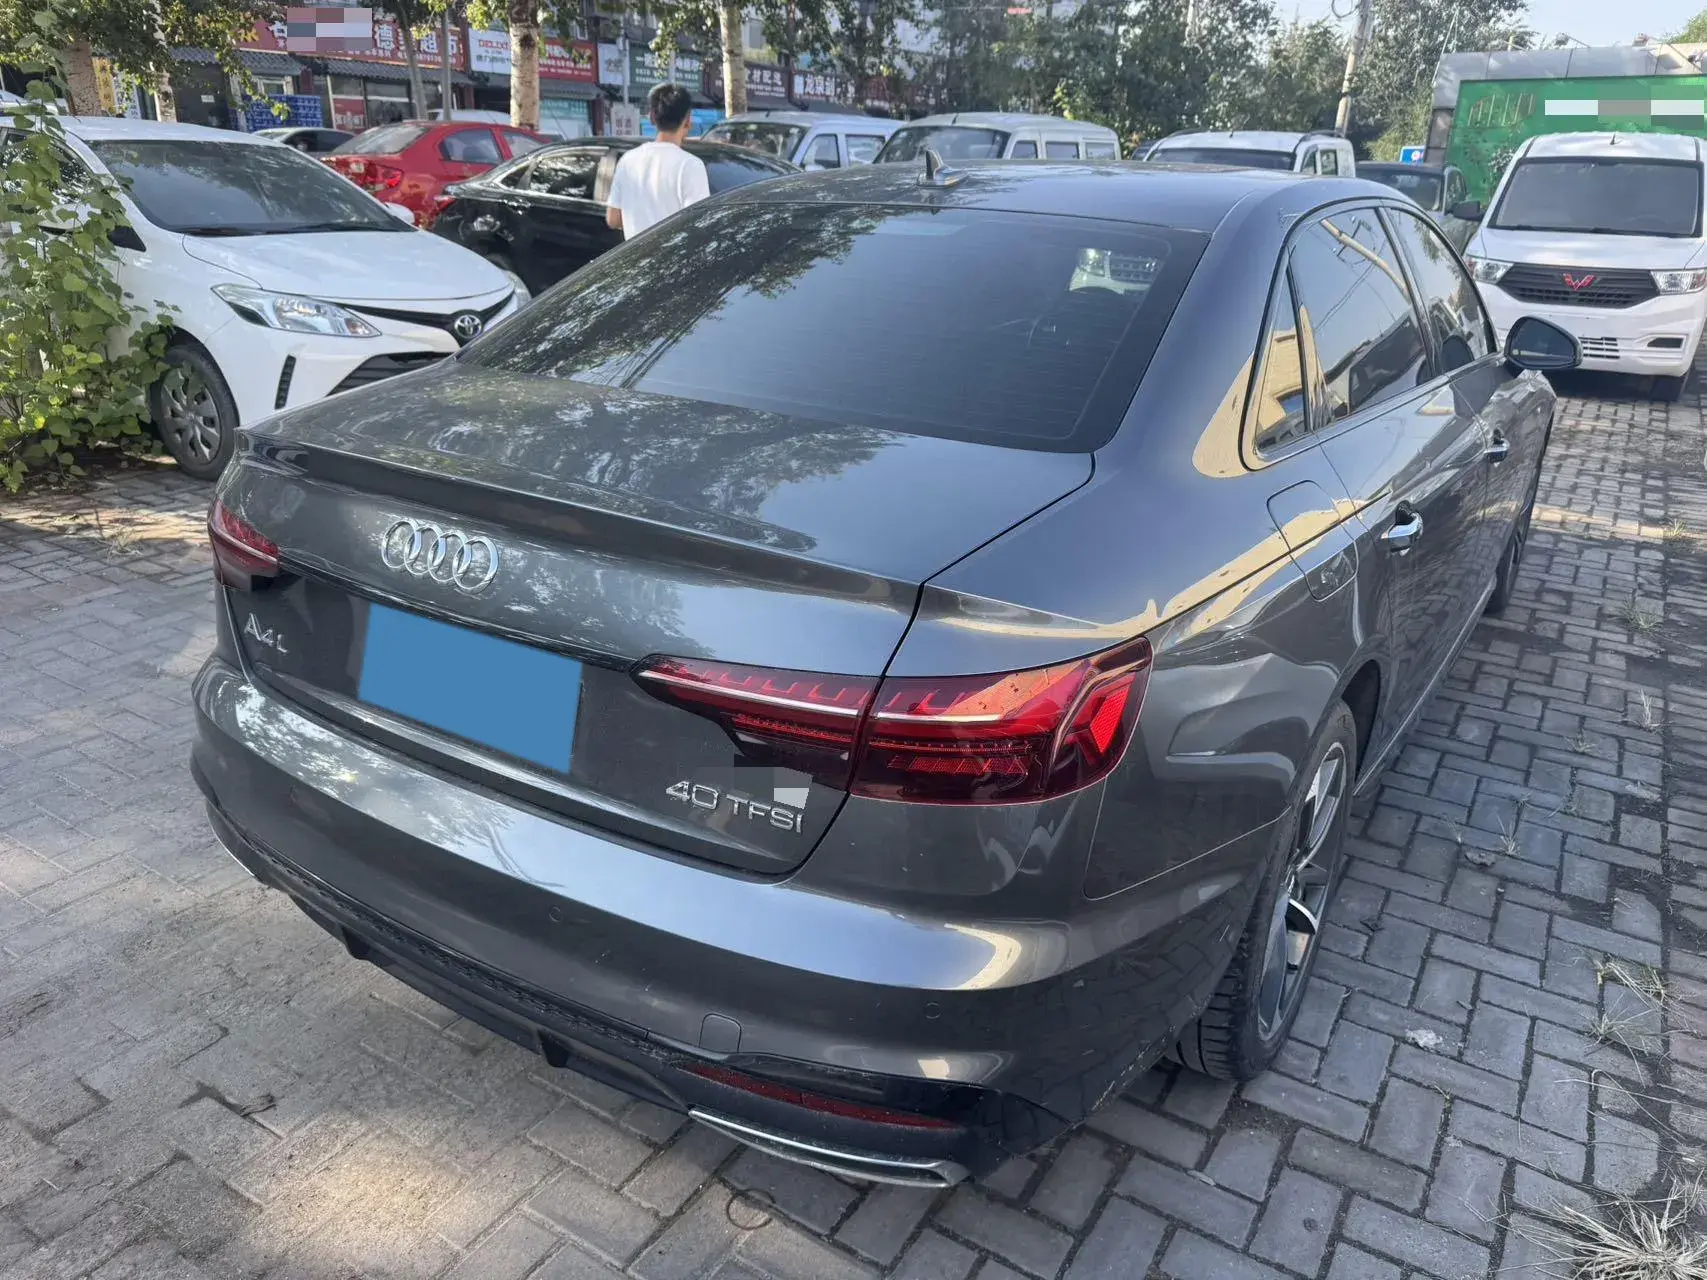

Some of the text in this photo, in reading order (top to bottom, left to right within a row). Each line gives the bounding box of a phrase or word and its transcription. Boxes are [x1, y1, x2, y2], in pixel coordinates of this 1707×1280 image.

[244, 612, 288, 653] A4L
[665, 780, 804, 833] 40 TFSI
